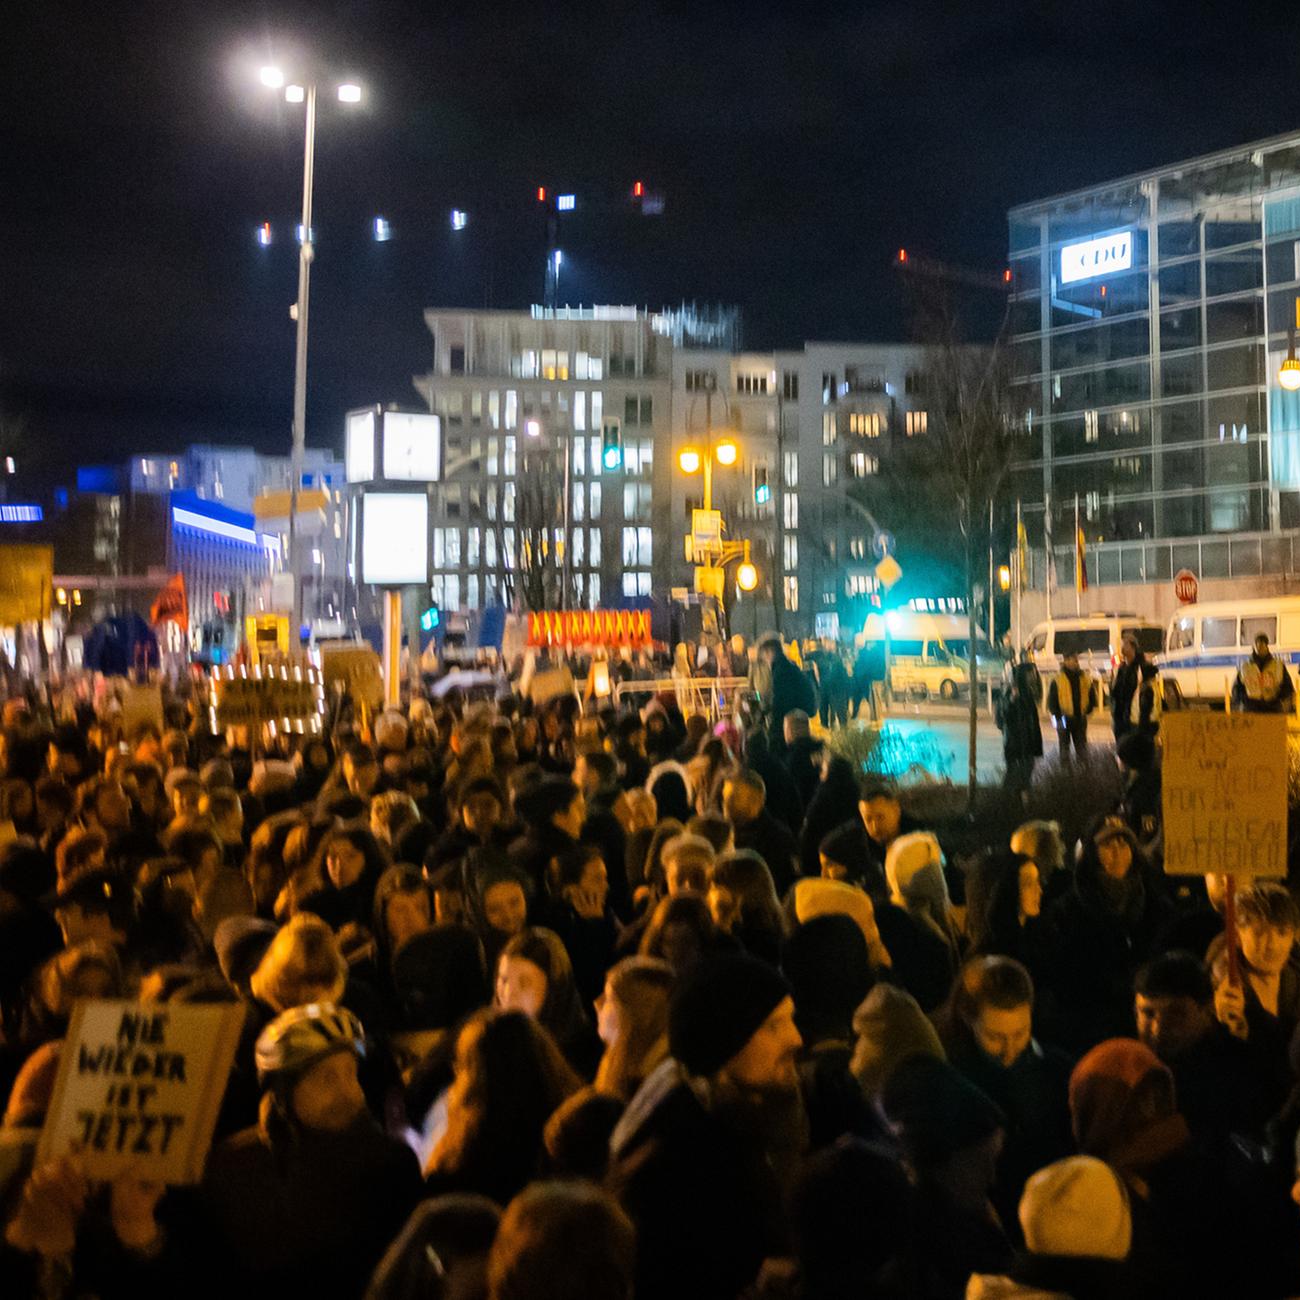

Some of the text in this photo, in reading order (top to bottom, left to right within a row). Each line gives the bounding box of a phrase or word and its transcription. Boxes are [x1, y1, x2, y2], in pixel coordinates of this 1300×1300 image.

[1176, 579, 1198, 599] STOP
[117, 1011, 169, 1047] NIE
[78, 1042, 188, 1084] WIEDER
[106, 1083, 158, 1111] IST
[76, 1110, 185, 1155] JETZT
